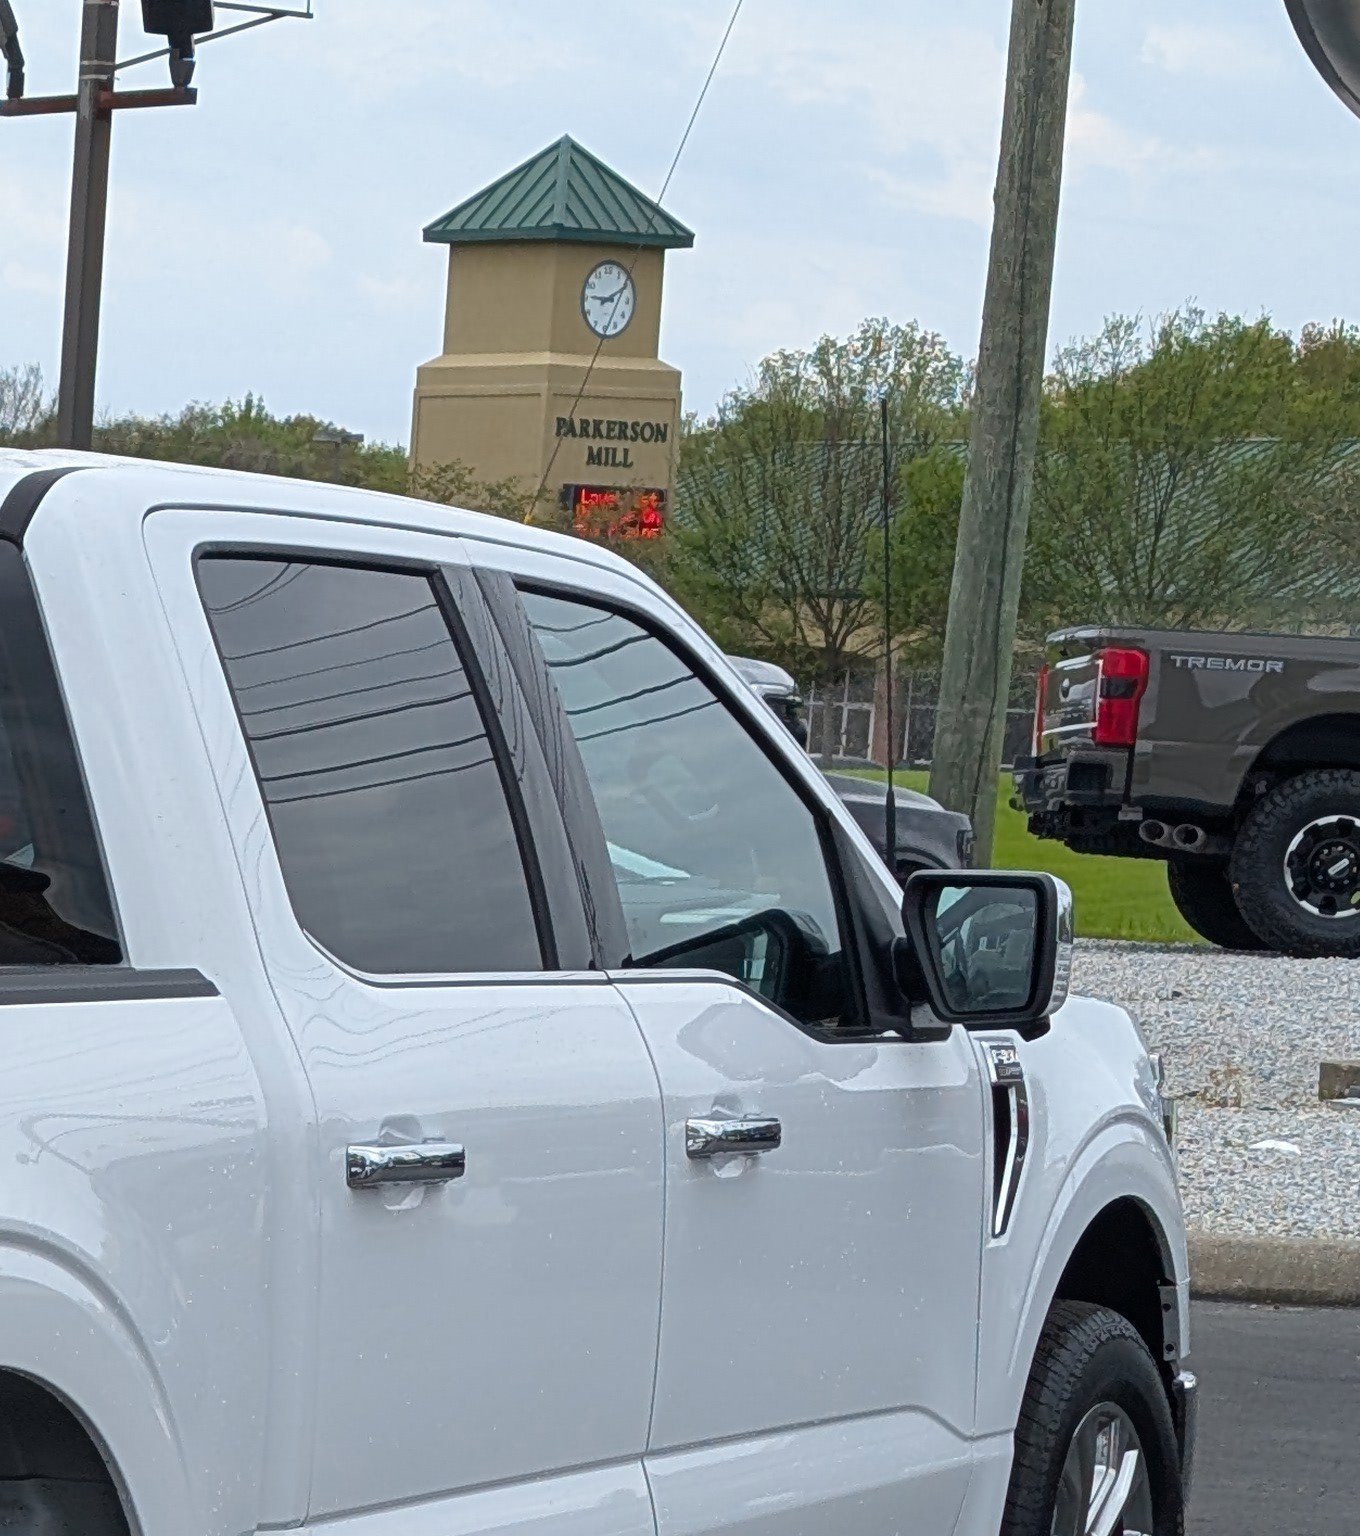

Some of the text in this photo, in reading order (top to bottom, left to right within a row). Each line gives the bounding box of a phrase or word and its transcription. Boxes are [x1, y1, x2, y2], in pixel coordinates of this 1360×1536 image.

[555, 417, 669, 443] PARKERSON
[586, 445, 633, 468] MILL
[1170, 655, 1285, 674] TREMOR
